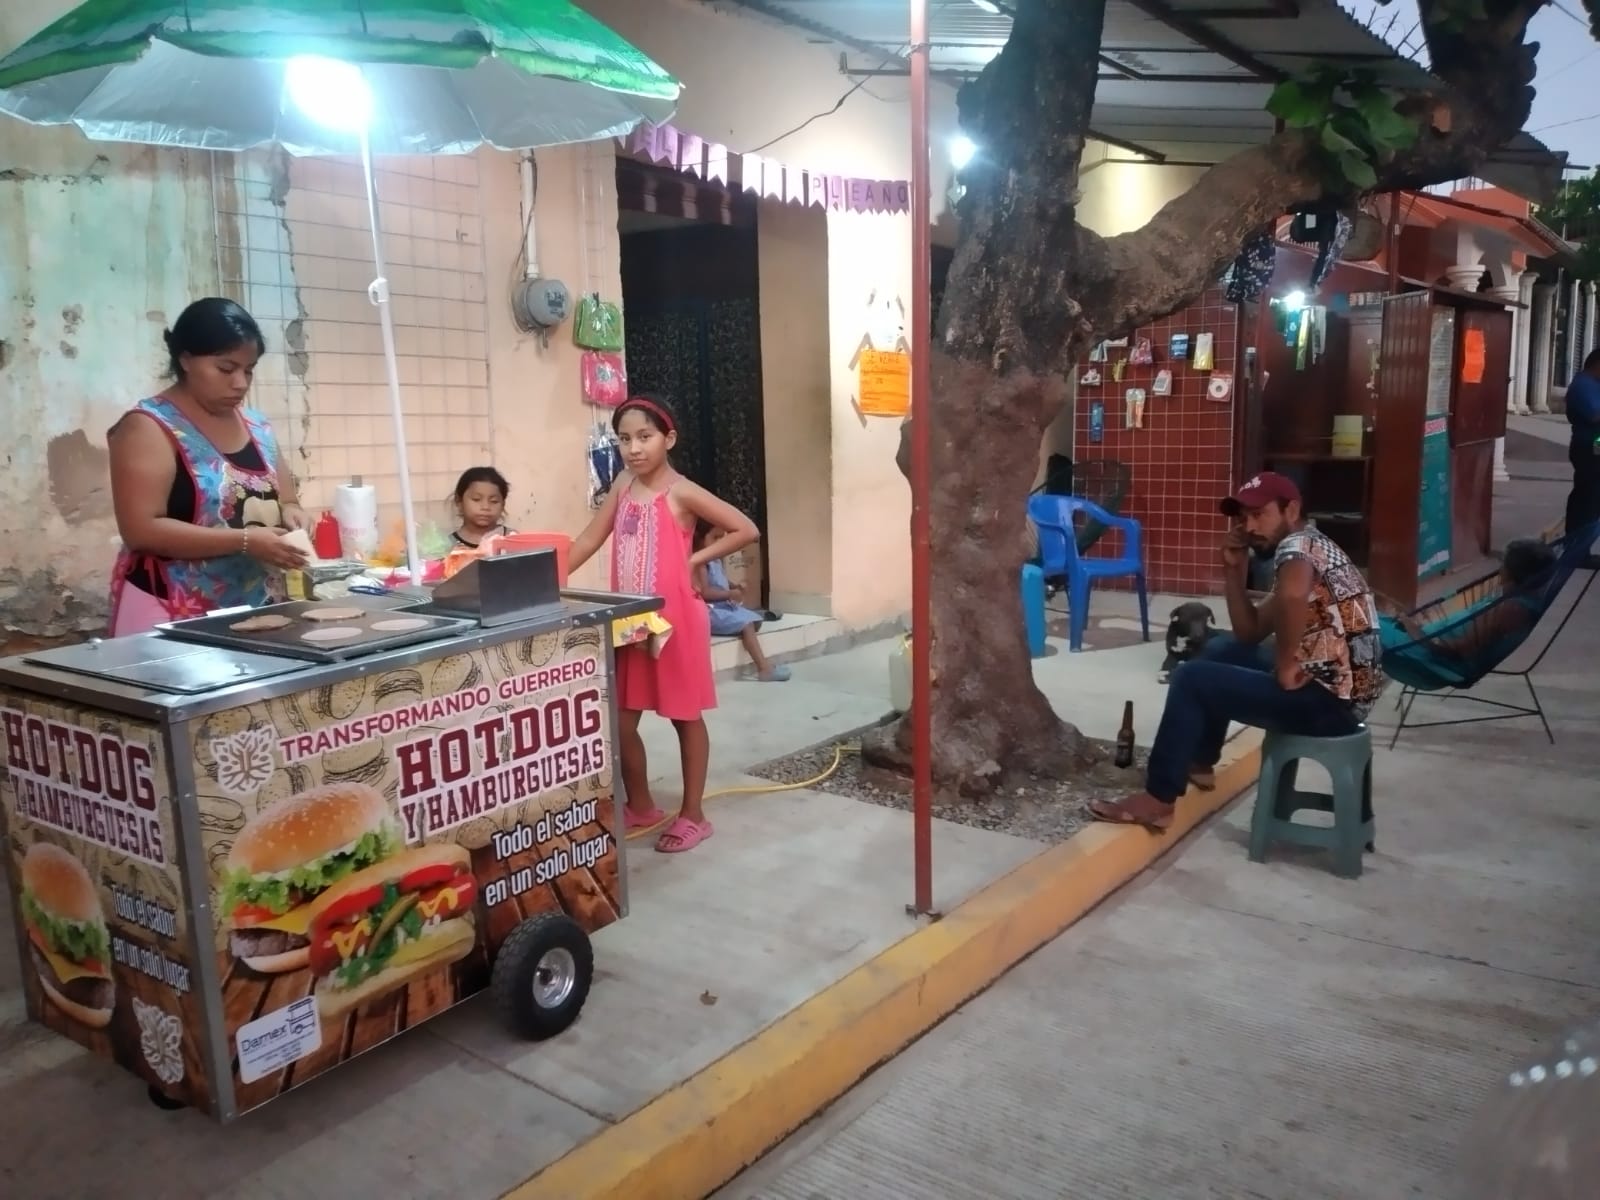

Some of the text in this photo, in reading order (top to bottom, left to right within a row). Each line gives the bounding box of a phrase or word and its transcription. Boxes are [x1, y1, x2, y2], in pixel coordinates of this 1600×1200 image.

[280, 657, 596, 761] TRANSFORMANDO GUERRERO
[24, 778, 164, 864] HAMBURGUESAS
[403, 738, 605, 840] Y HAMBURGUESAS
[492, 799, 598, 861] Todo el sabor
[485, 833, 610, 907] en un solo lugar
